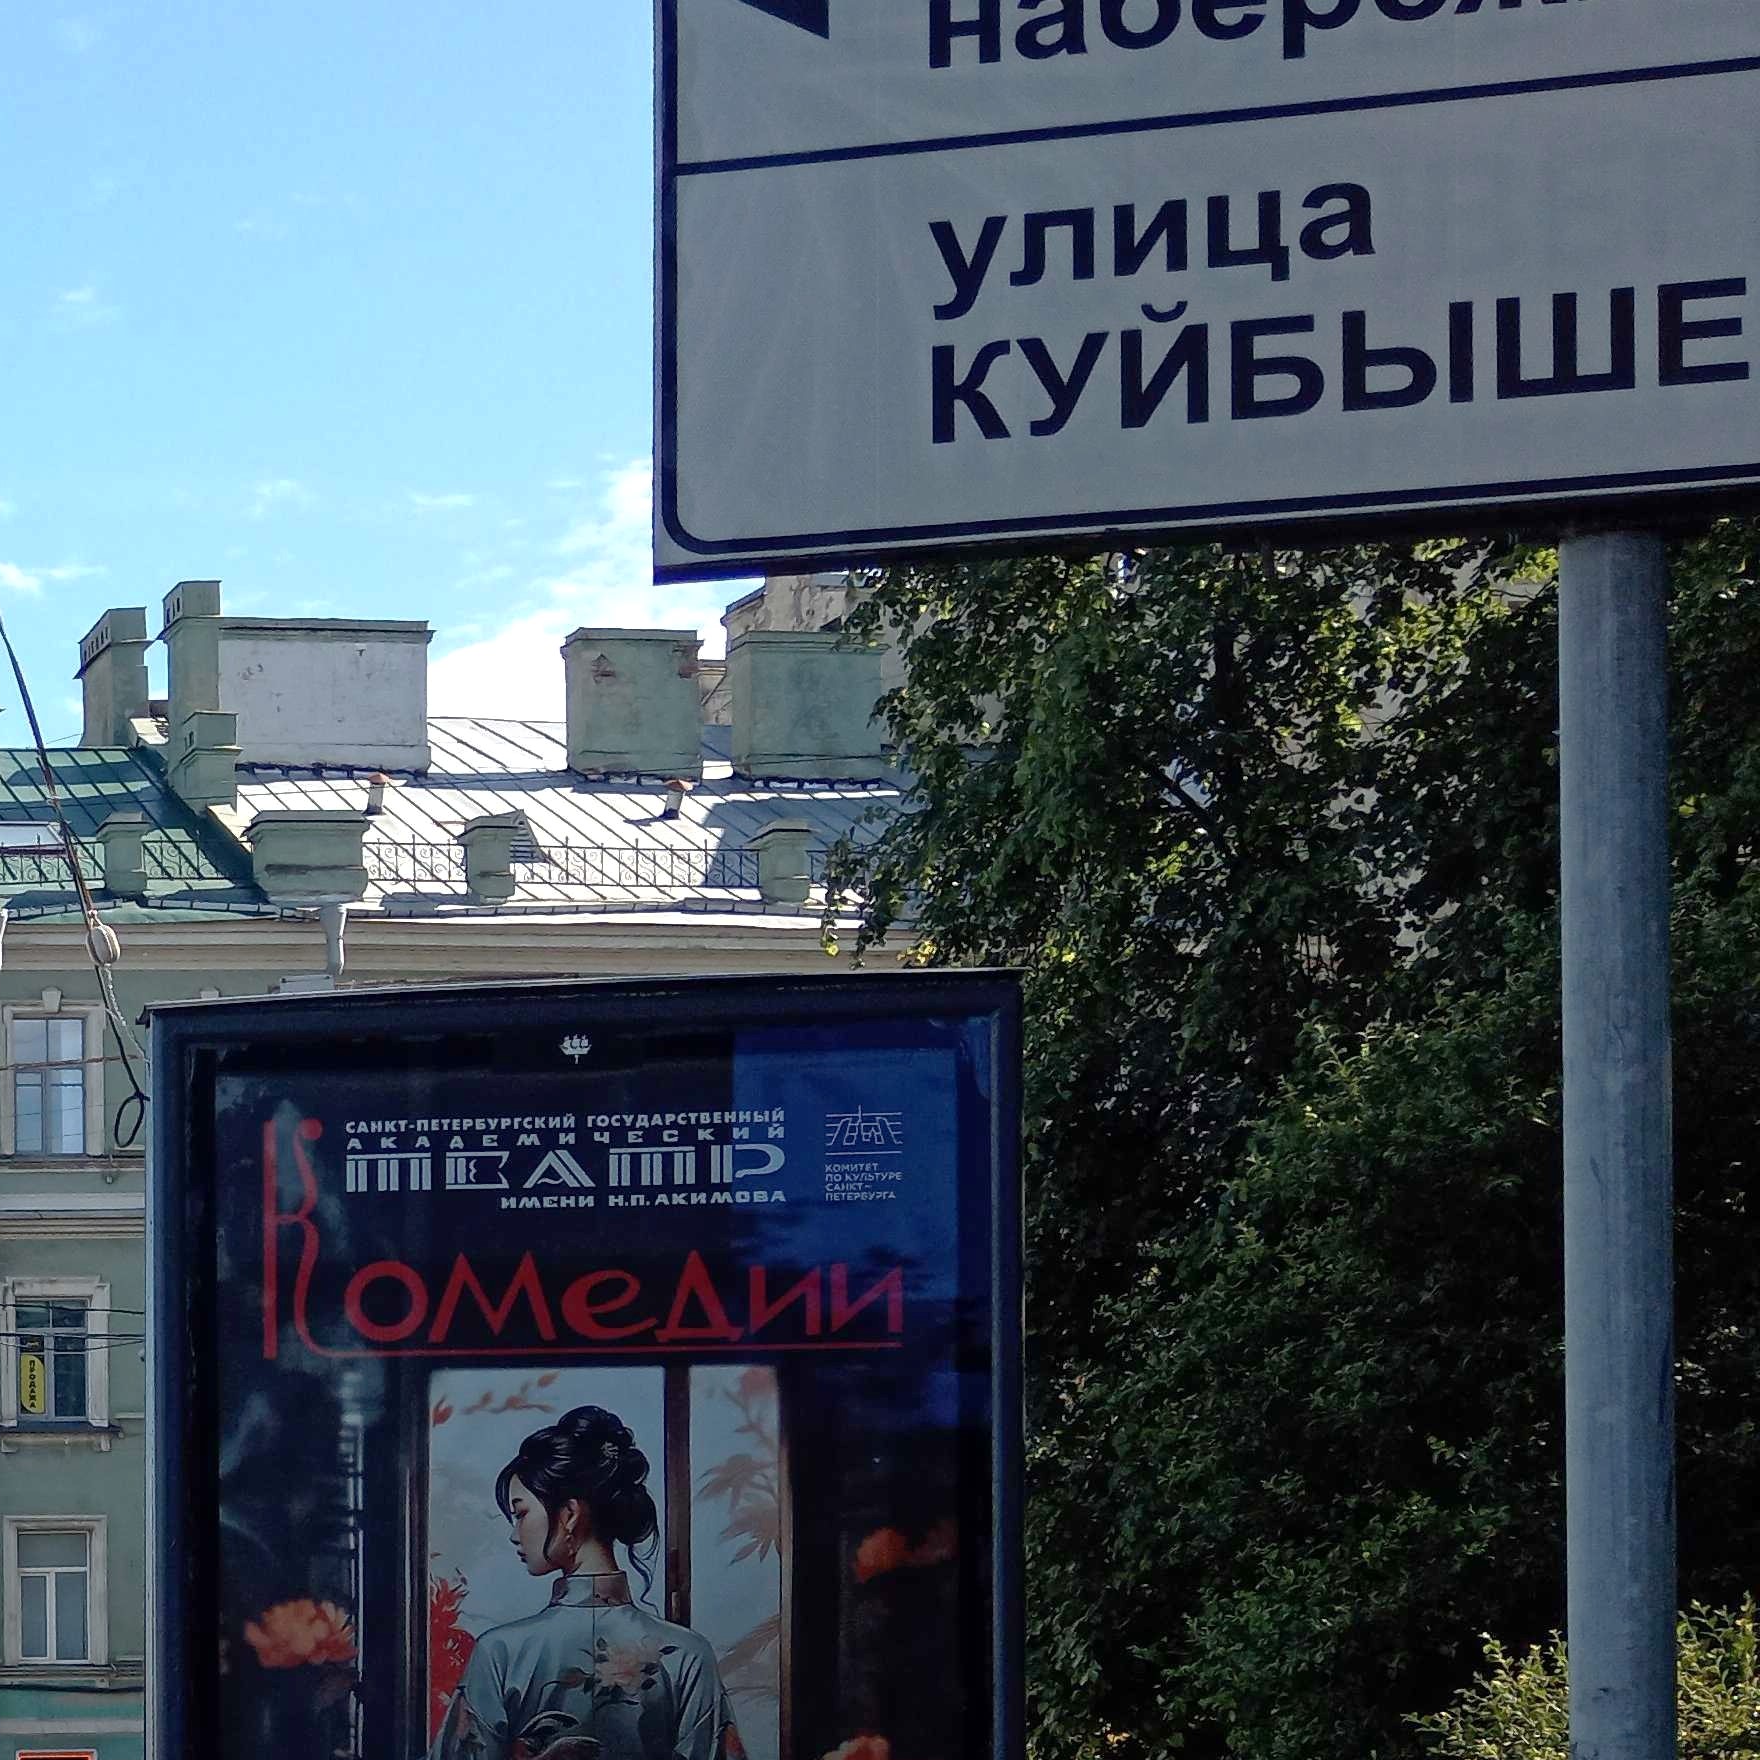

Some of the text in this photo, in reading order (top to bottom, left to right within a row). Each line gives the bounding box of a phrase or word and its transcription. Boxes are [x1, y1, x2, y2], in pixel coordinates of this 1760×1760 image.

[929, 0, 1578, 69] набер
[929, 182, 1375, 321] улица
[932, 277, 1750, 444] КУЙБЫШЕ
[345, 1107, 786, 1134] САНКТ-ПЕТЕРБУРГСКИЙ ГОСУДАРСТВЕННЫЙ
[347, 1125, 786, 1150] АКАДЕМИЧЕСКИЙ
[345, 1143, 787, 1193] ТЕАТР
[825, 1162, 879, 1173] КОМИТЕТ
[825, 1171, 903, 1182] ПО КУЛЬТУРЕ
[501, 1195, 595, 1210] ИМЕНИ
[655, 1190, 787, 1207] АКИМОВА
[825, 1191, 897, 1201] ПЕТЕРБУРГА
